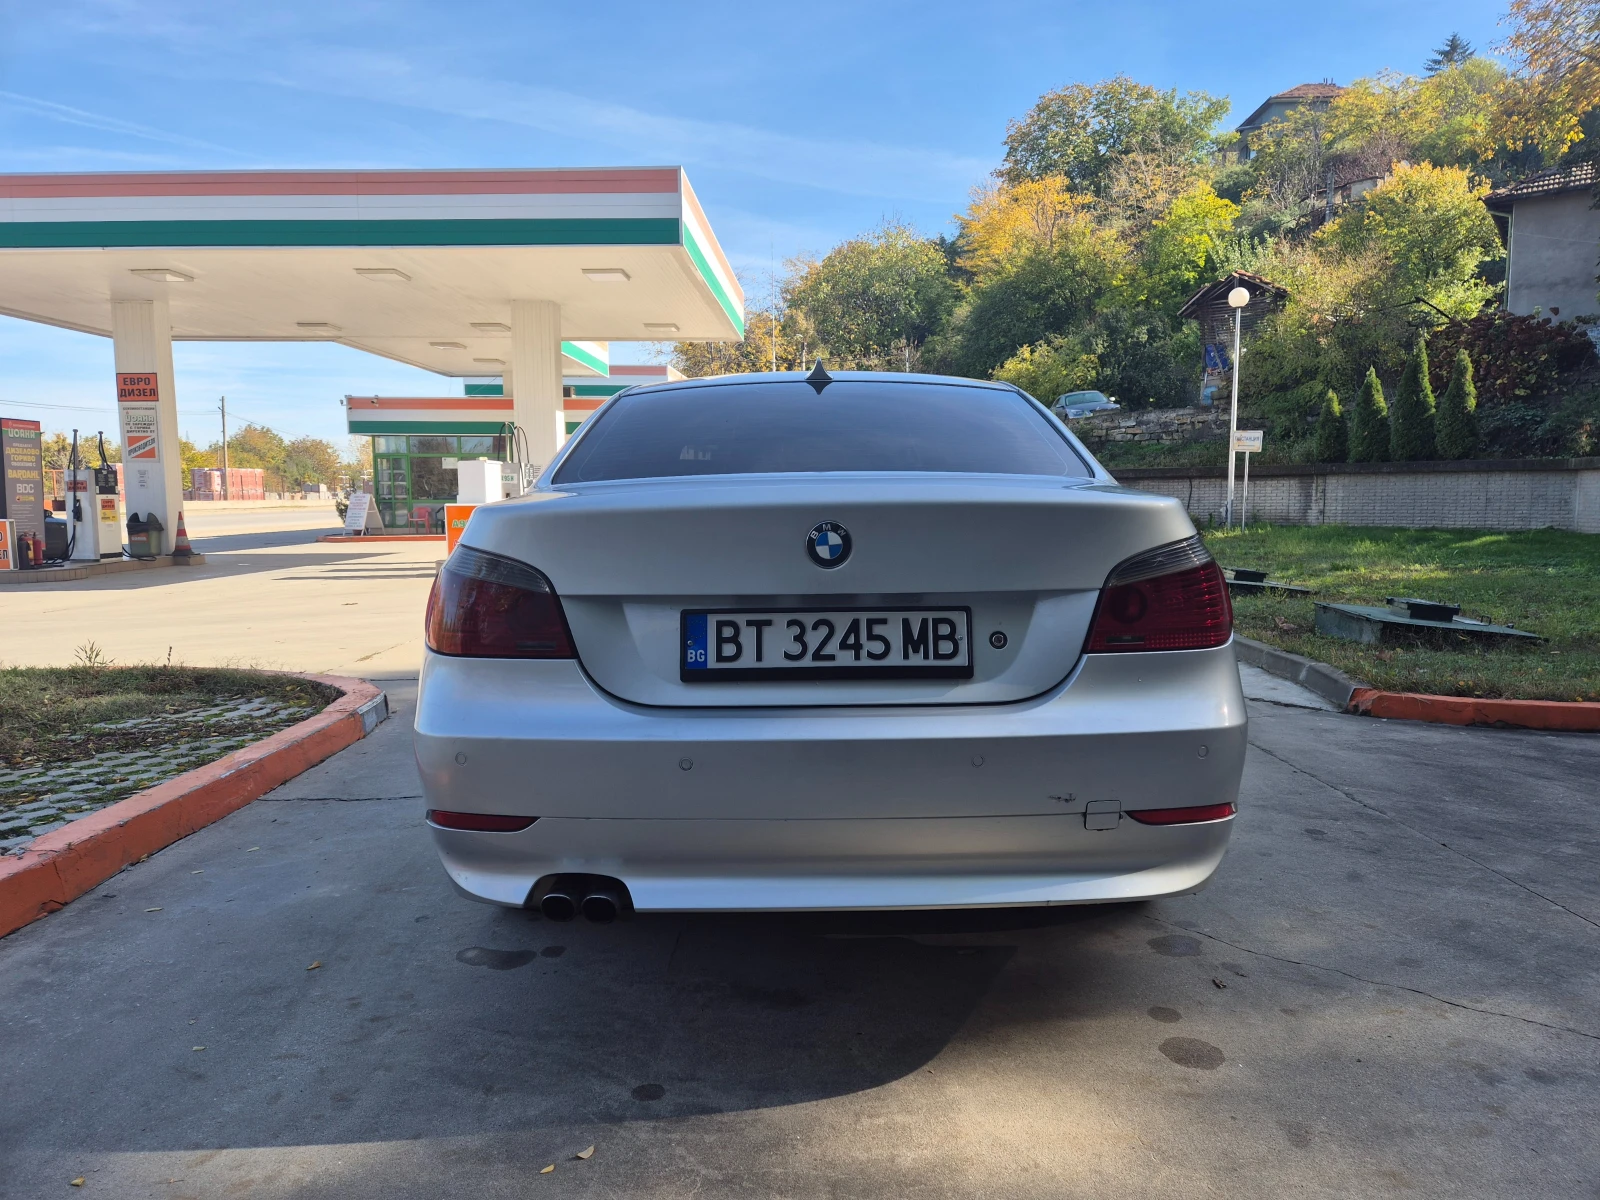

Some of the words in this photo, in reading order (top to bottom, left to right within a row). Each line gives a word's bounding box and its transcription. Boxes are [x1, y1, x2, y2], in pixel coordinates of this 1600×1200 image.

[123, 377, 151, 386] ЕВРО
[120, 388, 156, 398] ДИЗЕЛ
[5, 447, 40, 455] ДИЗЕЛОВО
[10, 454, 36, 462] ГОРИВО
[7, 469, 40, 480] BARDAHL
[16, 483, 34, 494] BDC
[810, 524, 846, 540] BMW
[715, 619, 772, 663] BT
[782, 617, 892, 661] 3245
[901, 617, 960, 661] MB
[687, 650, 705, 662] BG
